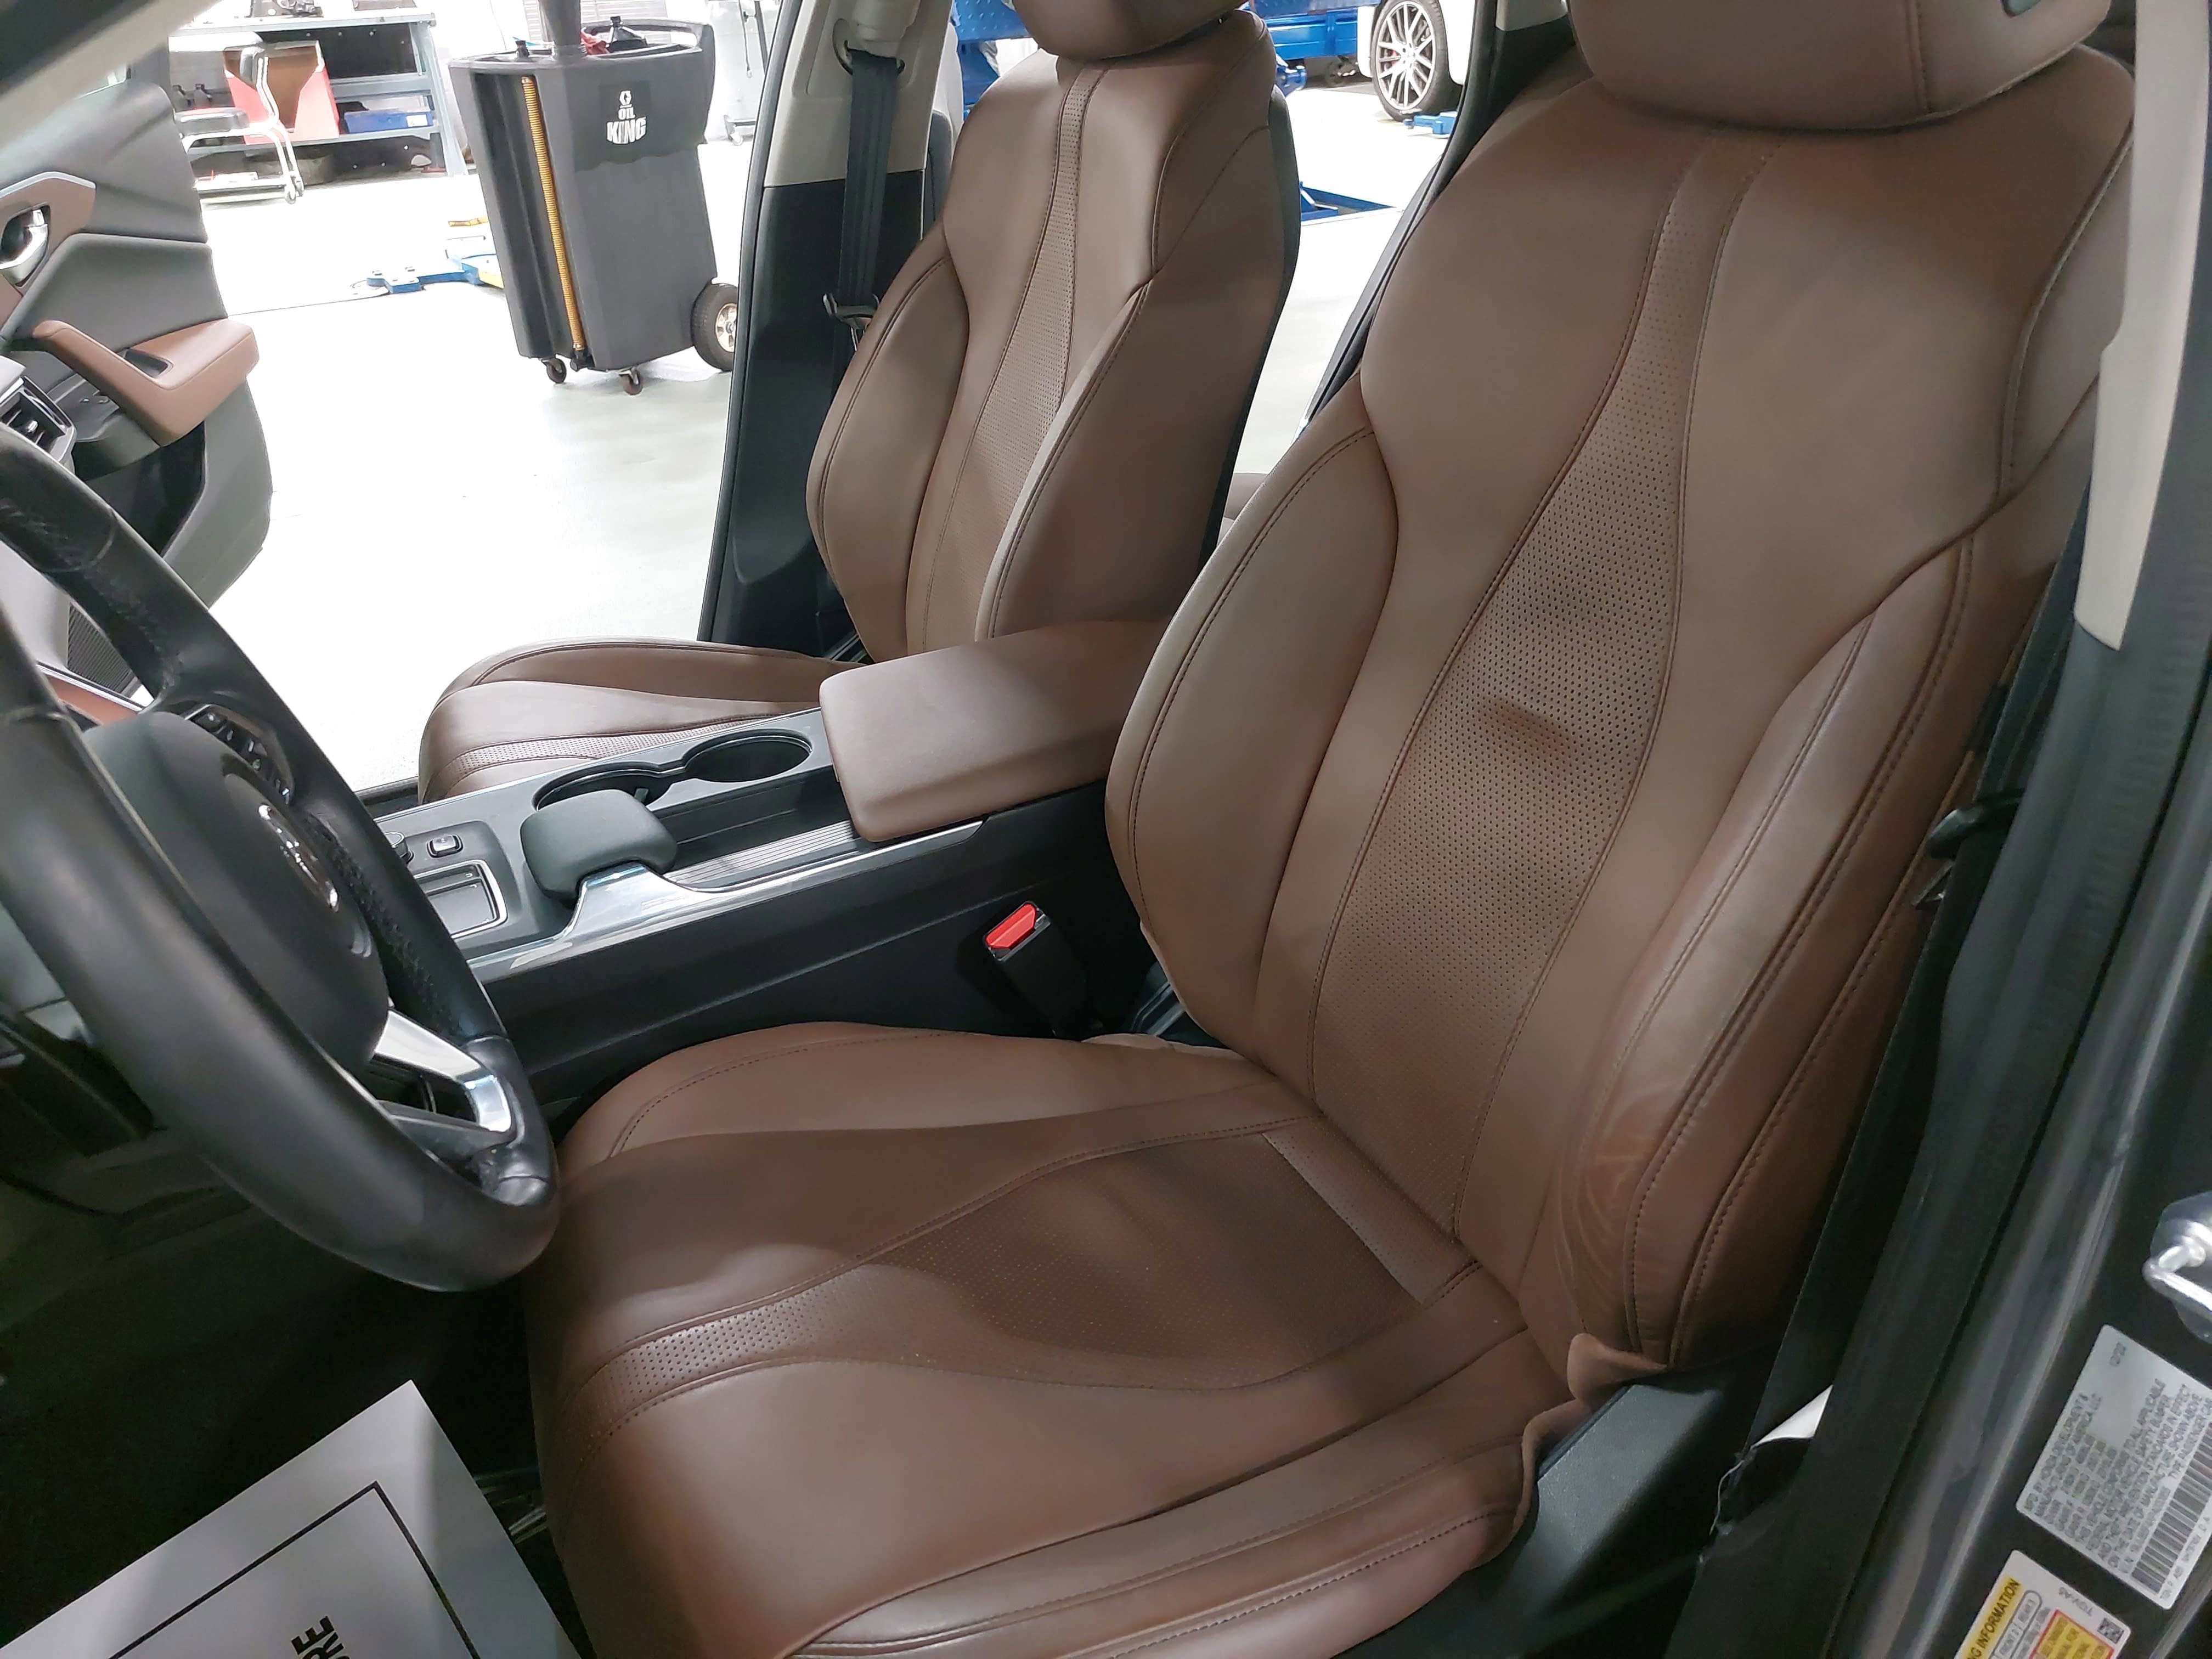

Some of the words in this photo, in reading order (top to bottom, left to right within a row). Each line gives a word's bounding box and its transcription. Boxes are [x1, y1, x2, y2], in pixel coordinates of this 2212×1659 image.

[618, 107, 635, 120] OIL
[606, 116, 646, 144] KING
[1977, 1577, 2020, 1649] INFORMATION
